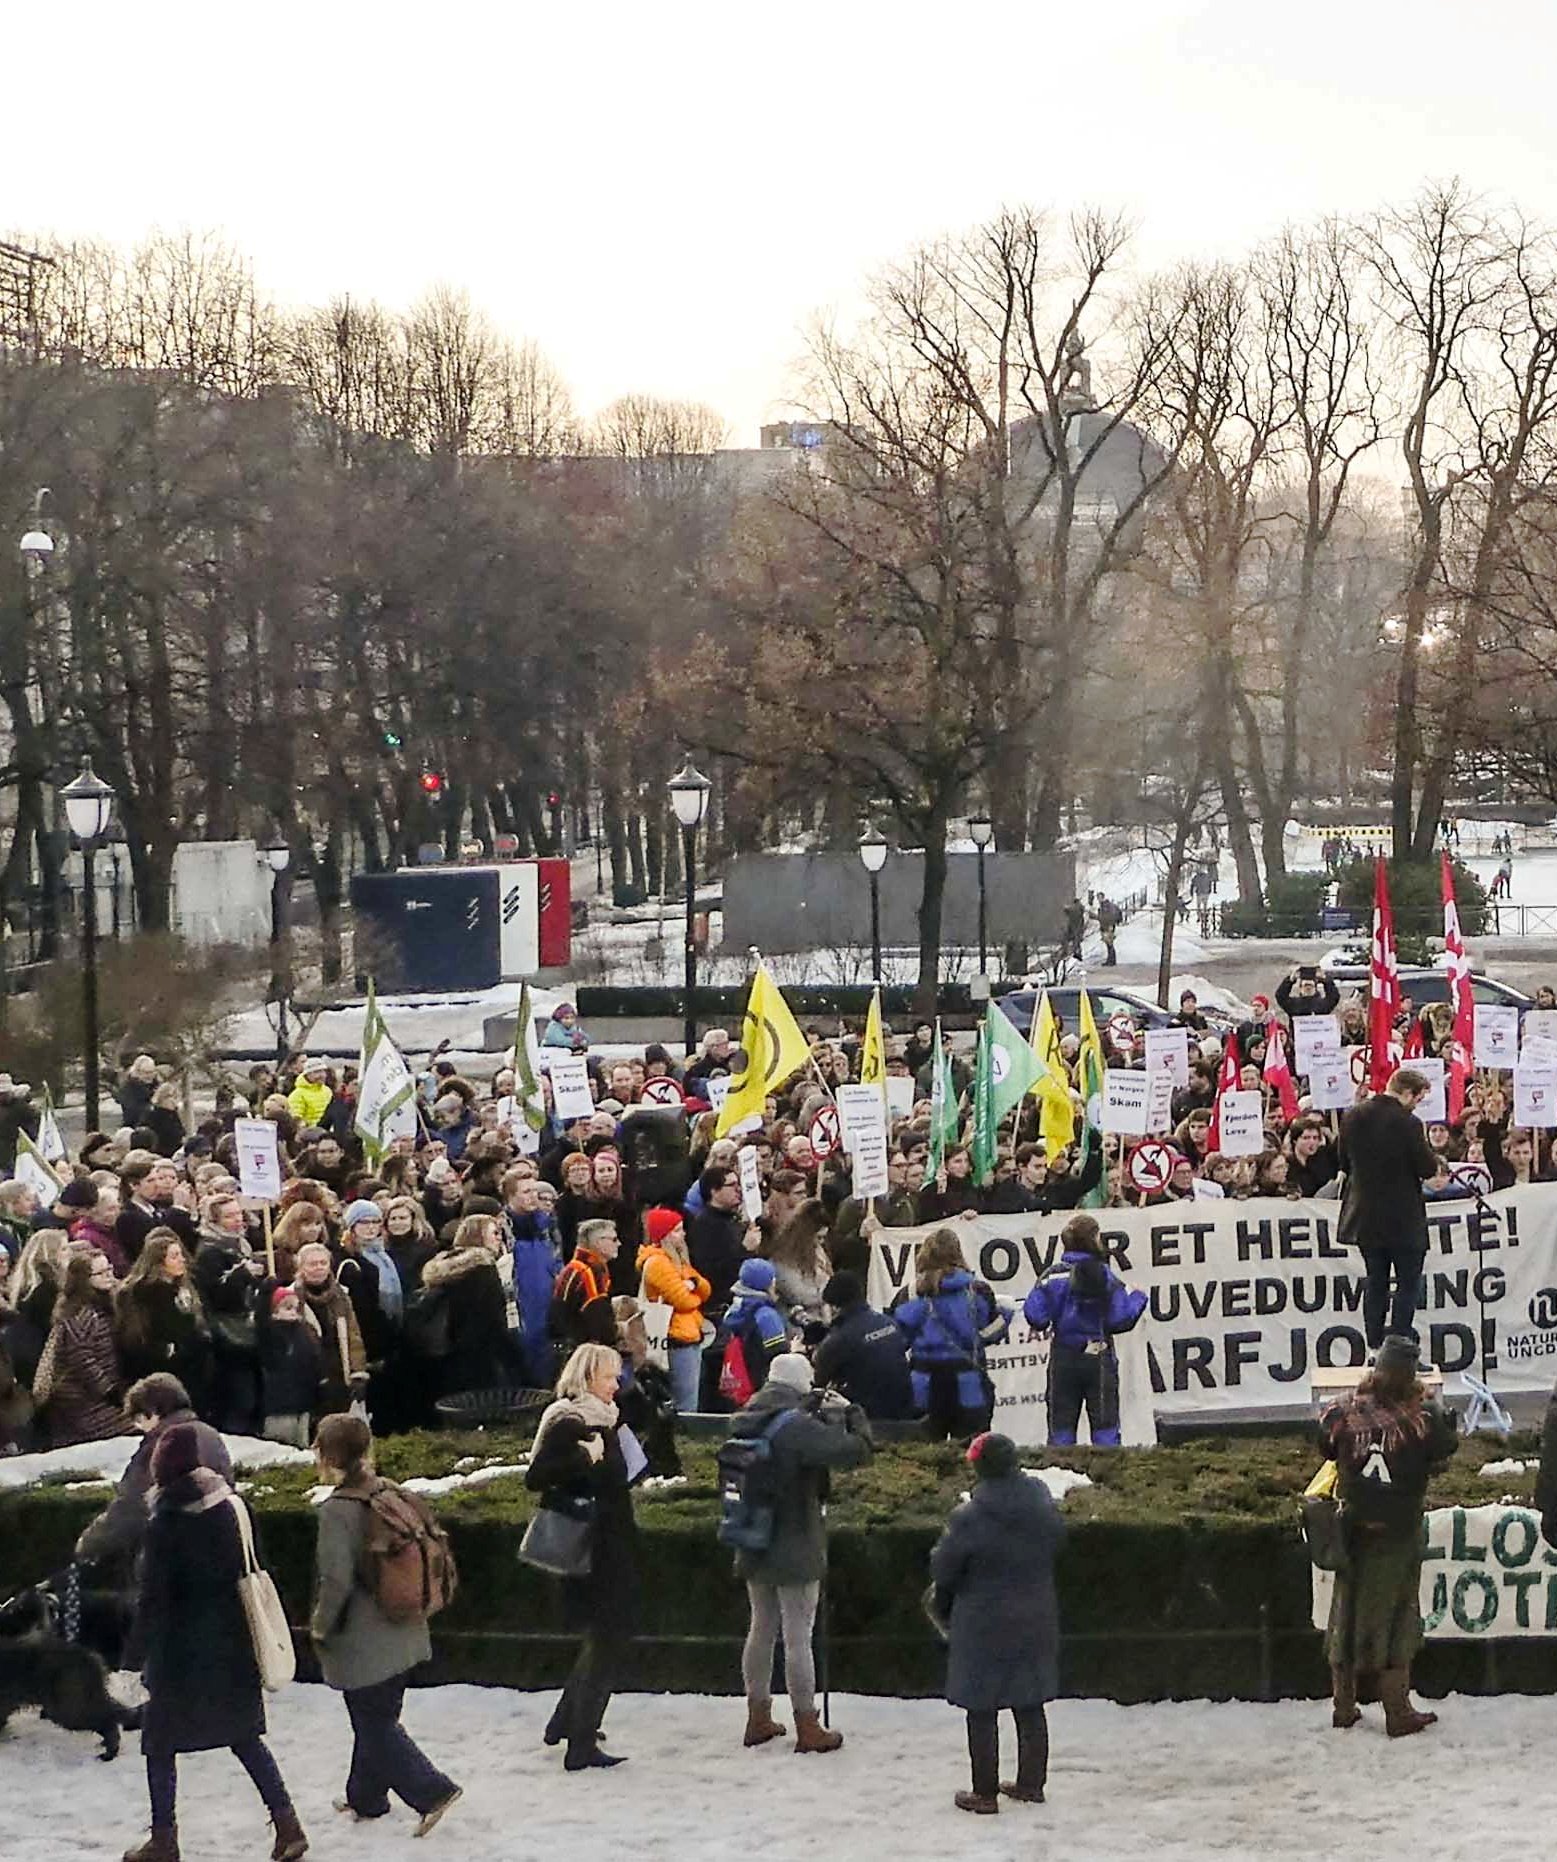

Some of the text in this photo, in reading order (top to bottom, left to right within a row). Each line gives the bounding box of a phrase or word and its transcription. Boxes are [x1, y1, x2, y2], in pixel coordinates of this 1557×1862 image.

[1109, 1097, 1142, 1109] Skam
[979, 1231, 1133, 1281] OVR
[1151, 1223, 1215, 1267] ET
[1236, 1206, 1520, 1261] HELTE!
